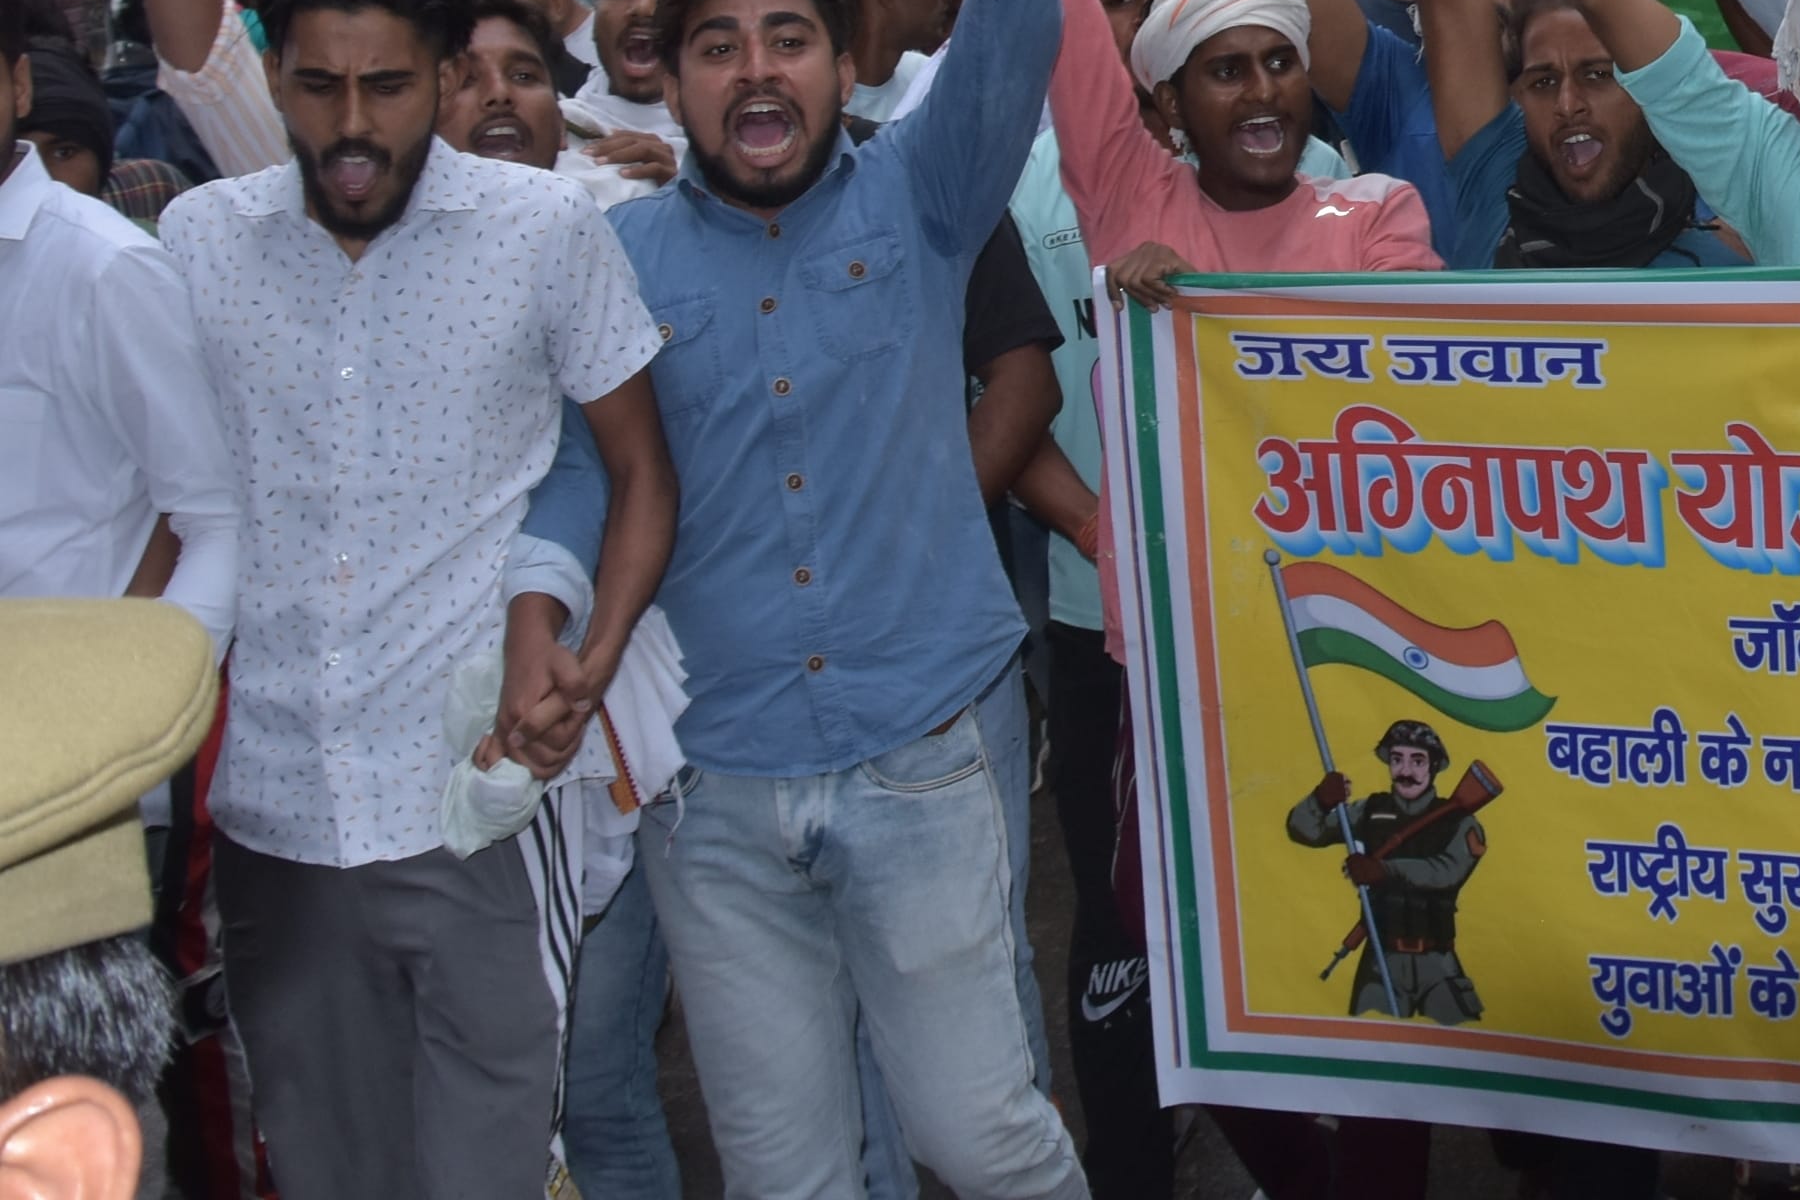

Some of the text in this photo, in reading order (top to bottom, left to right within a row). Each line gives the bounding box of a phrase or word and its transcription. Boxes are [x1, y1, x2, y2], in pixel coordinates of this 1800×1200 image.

[1232, 334, 1605, 386] जय जवान
[1253, 404, 1662, 558] अग्निपथ
[1545, 706, 1688, 785] बहाली
[1697, 713, 1752, 787] के
[1585, 822, 1728, 922] राष्ट्रीय
[1086, 957, 1149, 995] NIKE
[1588, 943, 1743, 1038] युवाओं
[1746, 948, 1800, 1020] के
